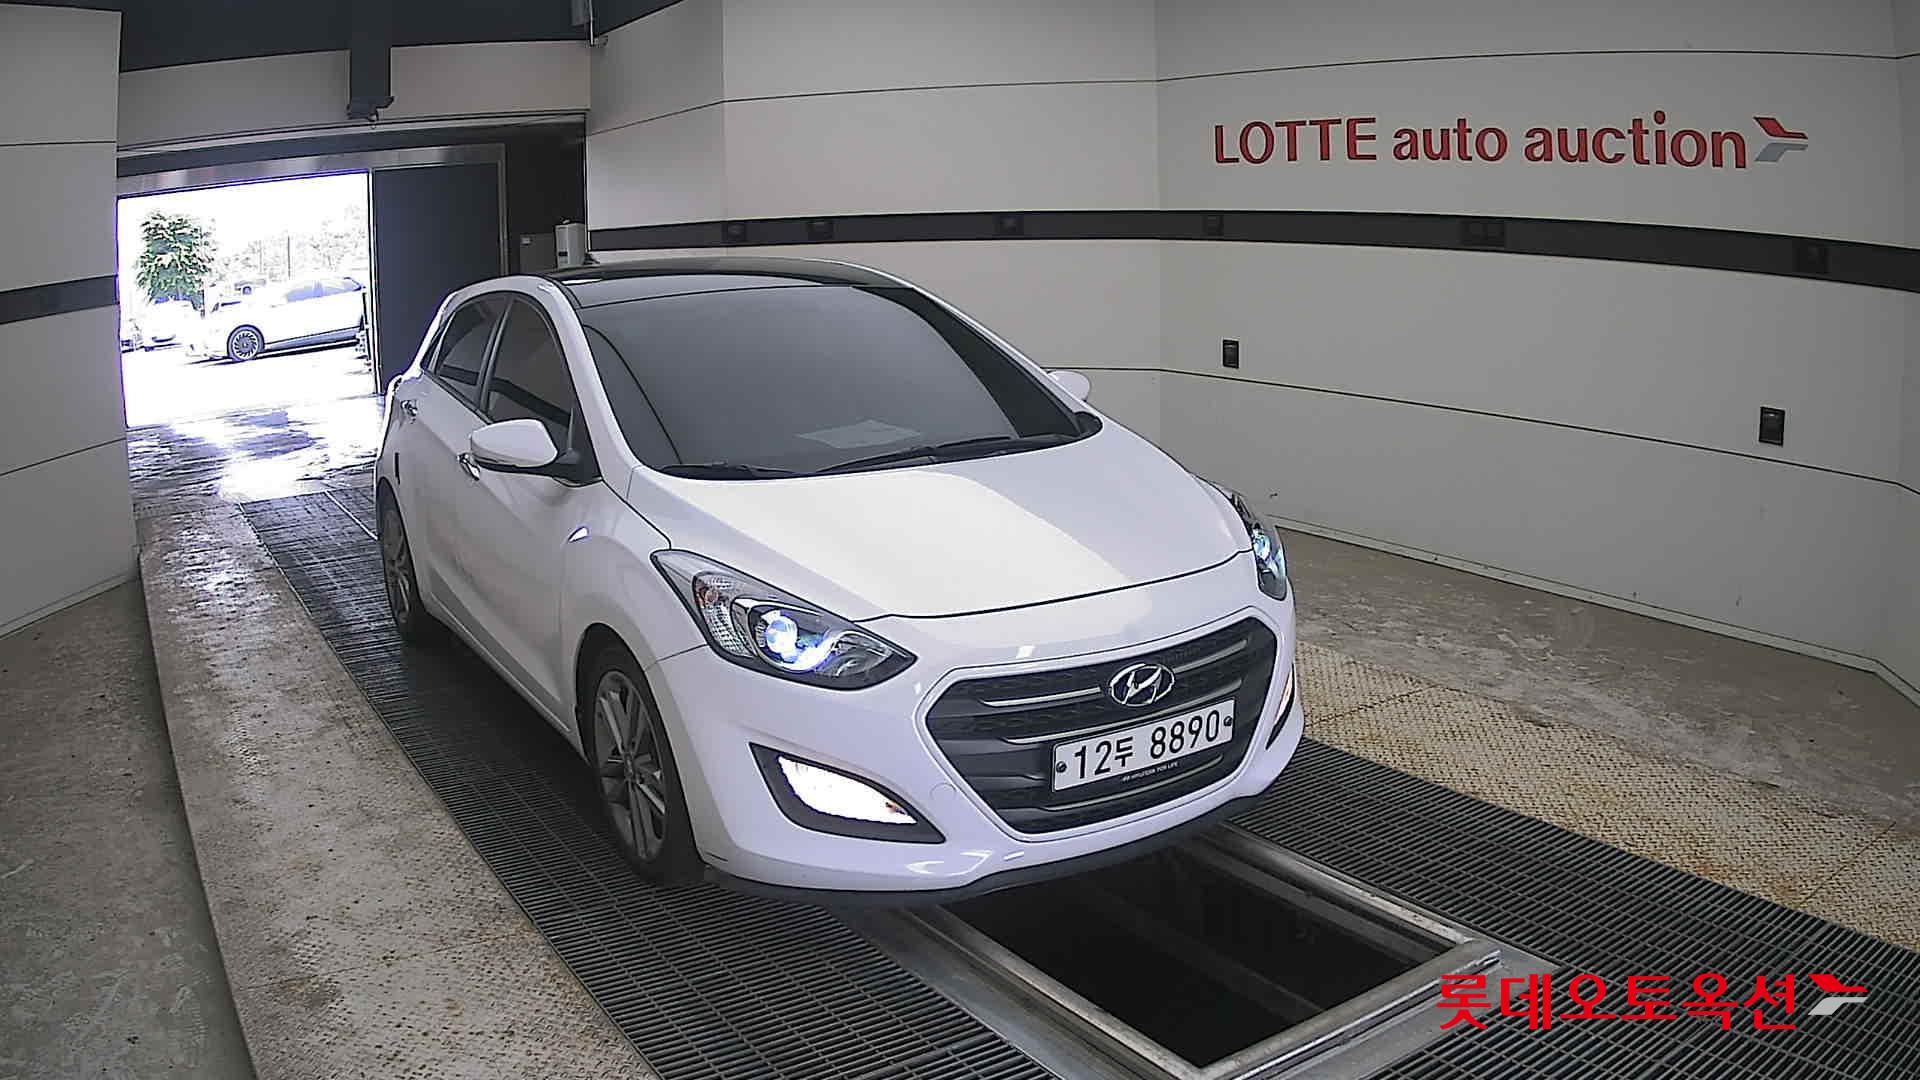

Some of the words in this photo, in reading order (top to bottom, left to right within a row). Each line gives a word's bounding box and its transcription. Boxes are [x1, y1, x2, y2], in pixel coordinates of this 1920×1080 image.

[1215, 117, 1377, 164] LOTTE
[1392, 118, 1509, 161] auto
[1524, 111, 1747, 168] auction
[1074, 736, 1134, 779] 12두
[1150, 710, 1220, 759] 8890
